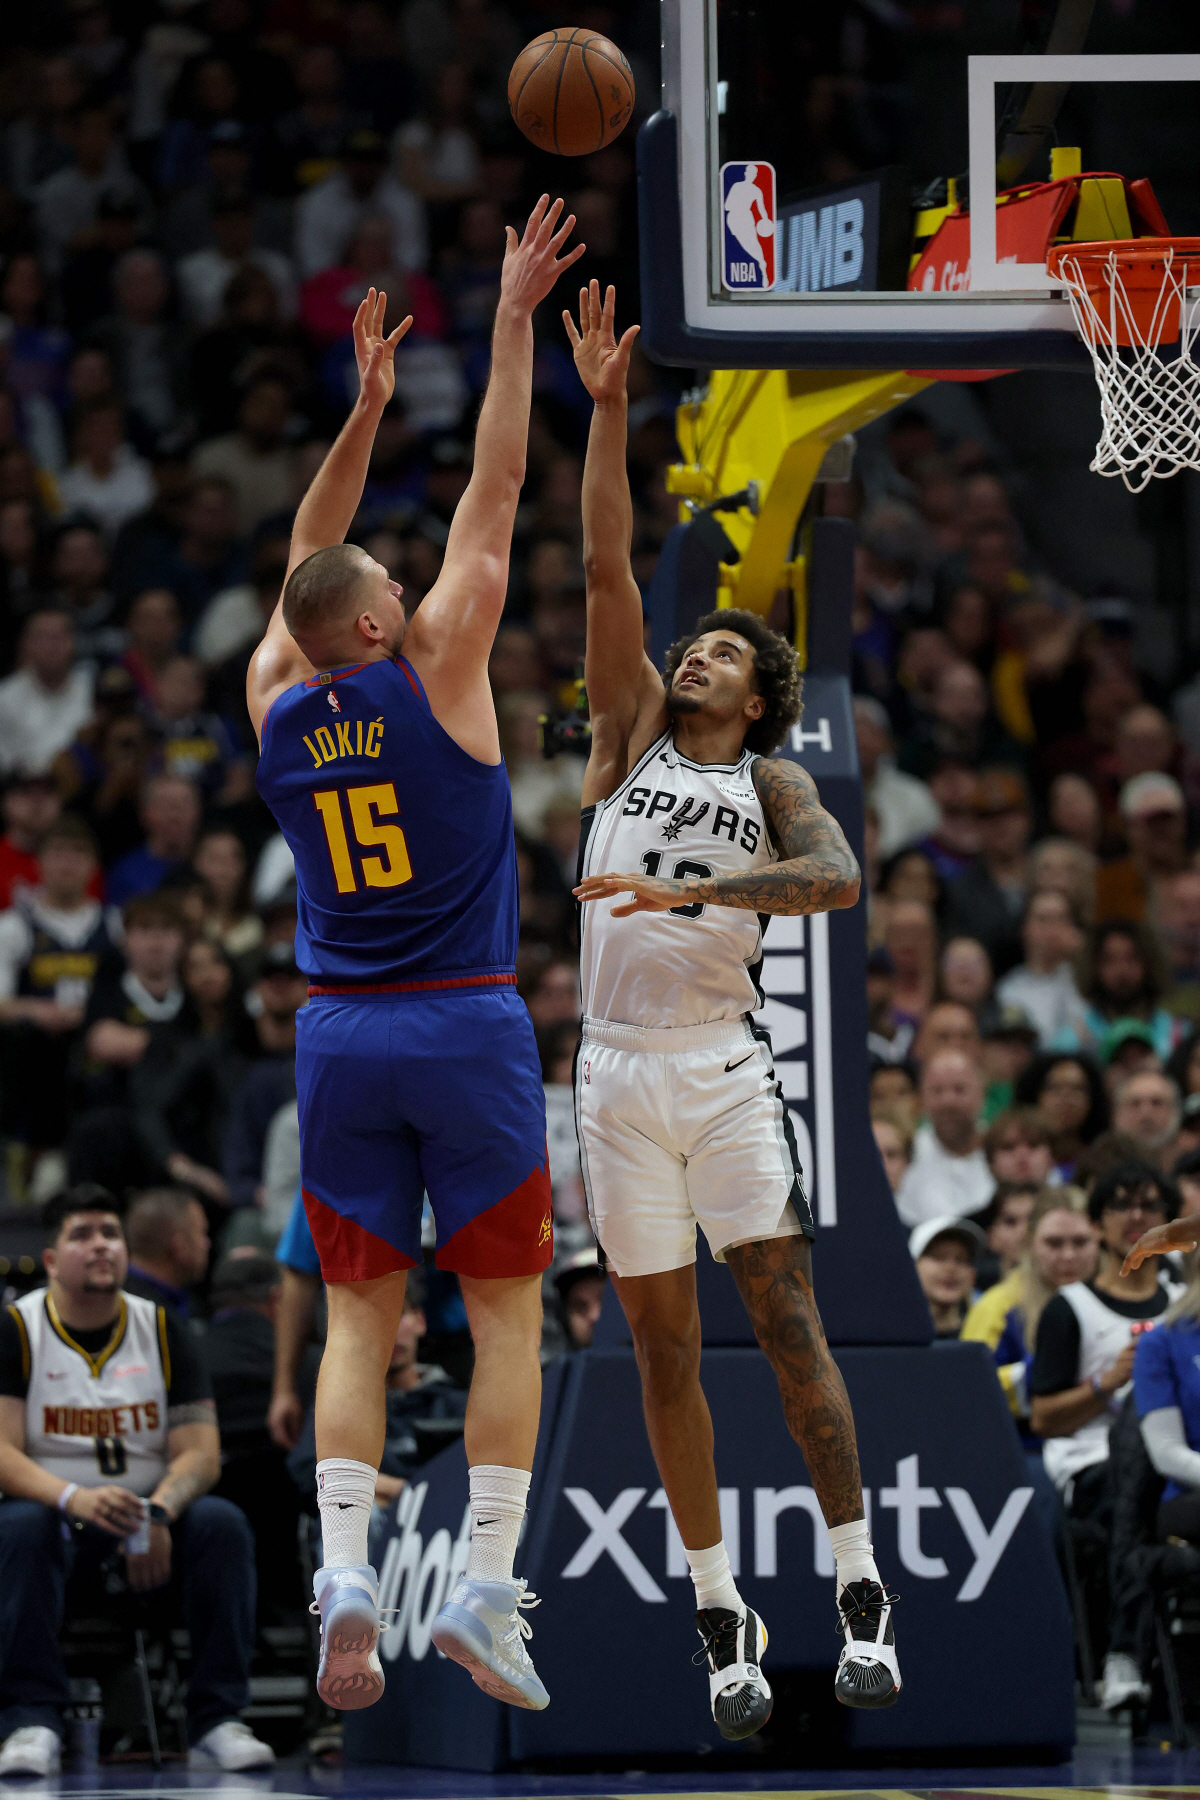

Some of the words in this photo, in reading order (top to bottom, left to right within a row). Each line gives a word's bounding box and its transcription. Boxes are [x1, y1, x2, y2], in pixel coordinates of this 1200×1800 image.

[730, 262, 757, 282] NBA
[302, 716, 384, 769] JOKIĆ
[311, 780, 415, 896] 15
[622, 787, 761, 856] SPURS
[43, 1401, 160, 1438] NUGGETS
[96, 1436, 127, 1477] 0
